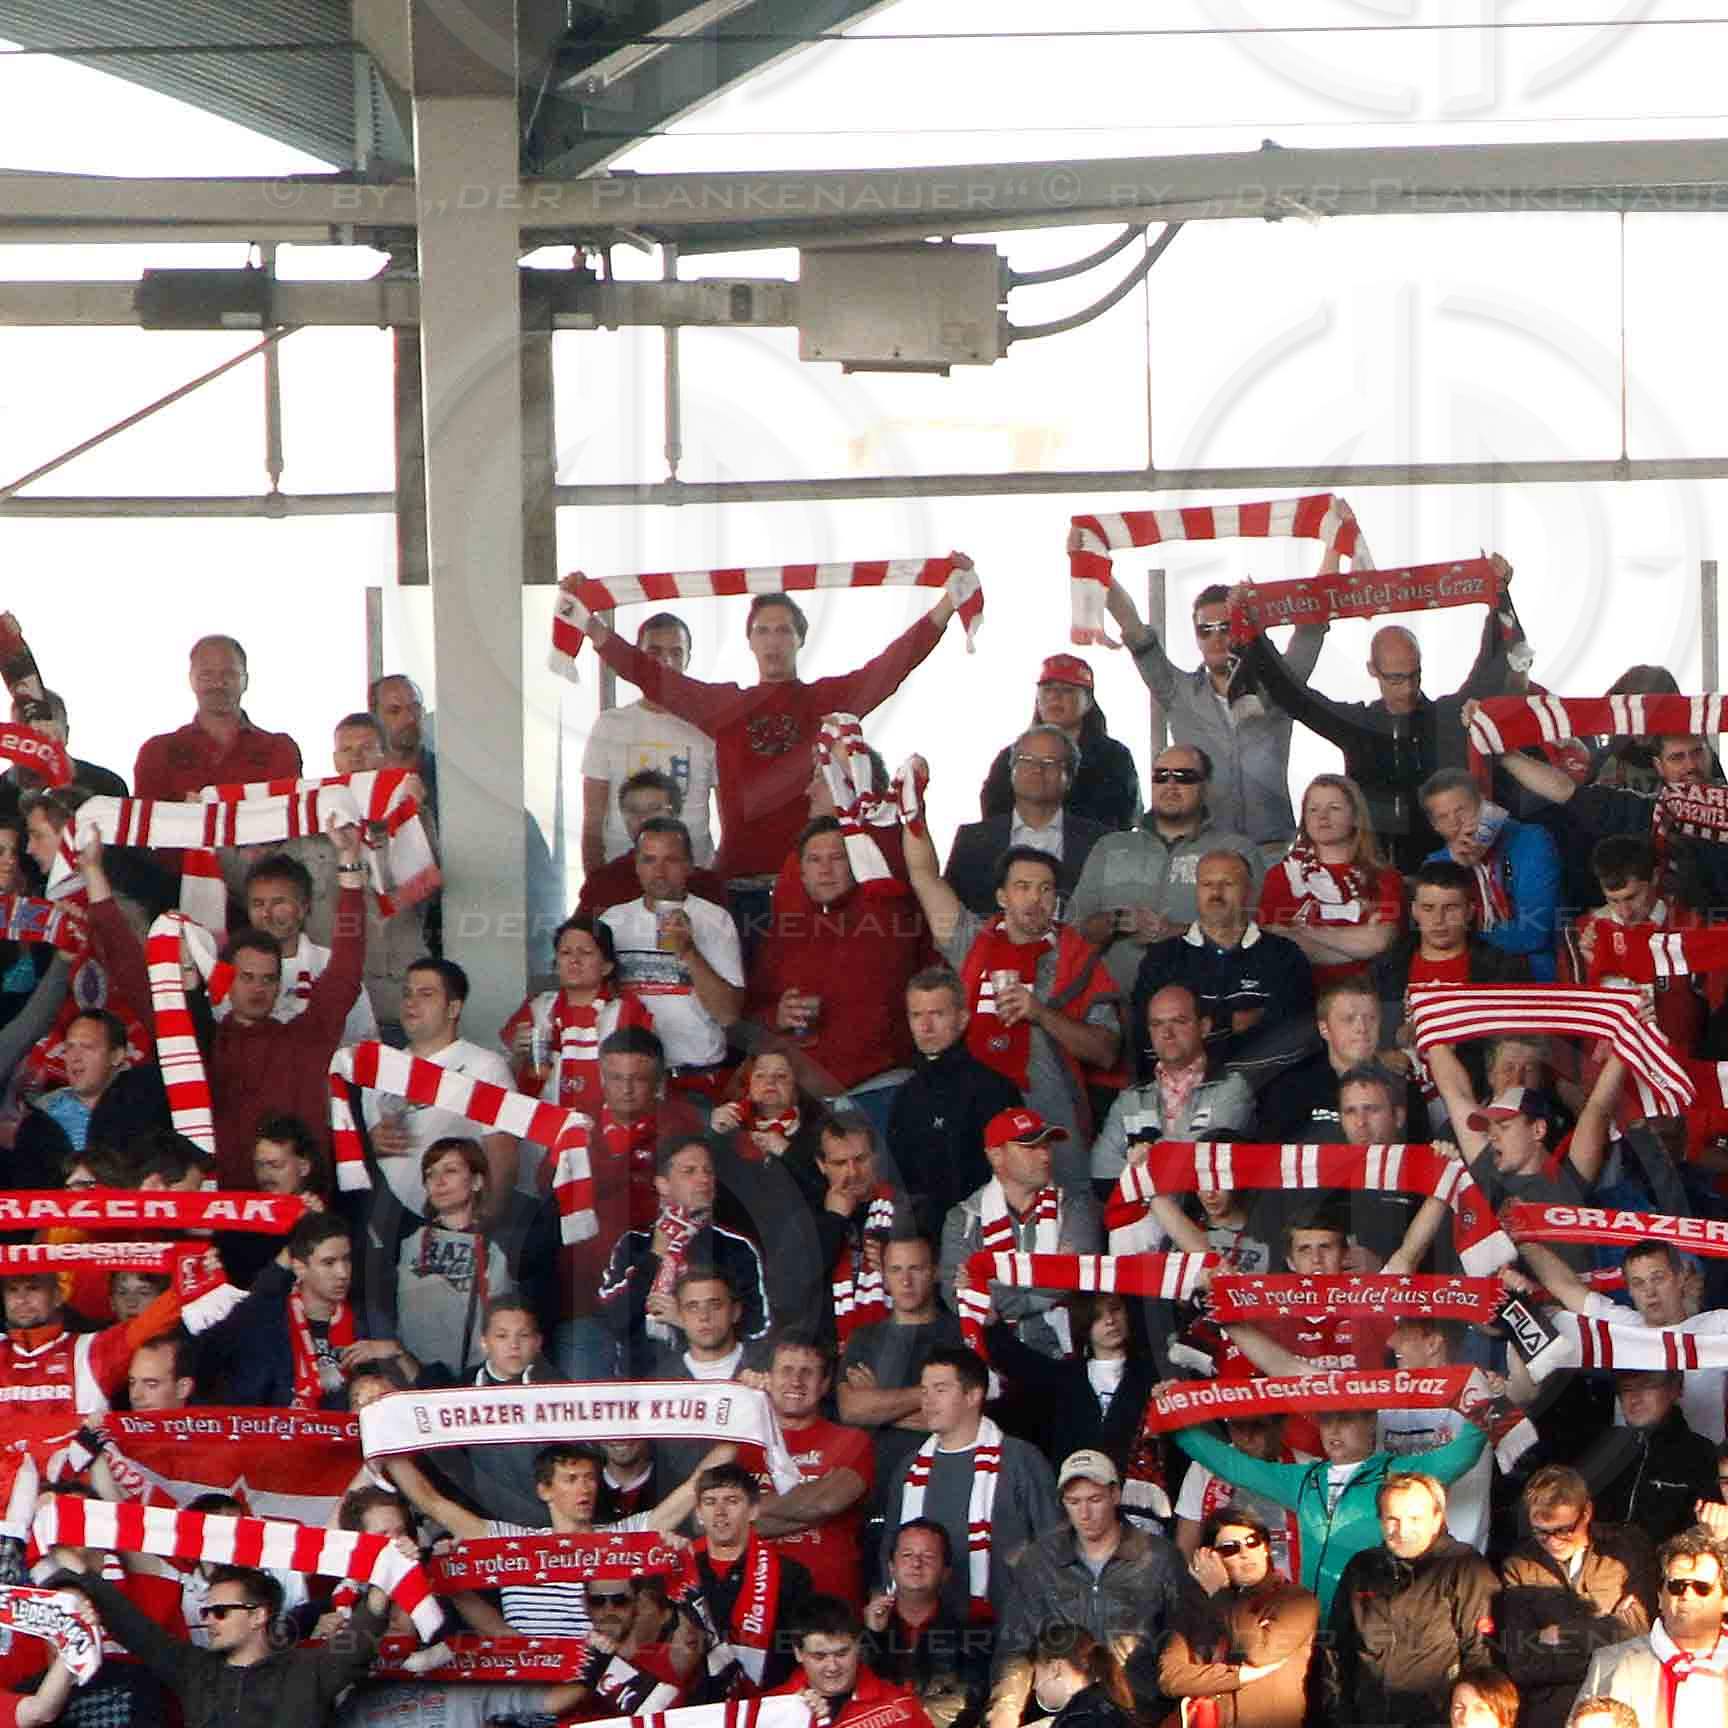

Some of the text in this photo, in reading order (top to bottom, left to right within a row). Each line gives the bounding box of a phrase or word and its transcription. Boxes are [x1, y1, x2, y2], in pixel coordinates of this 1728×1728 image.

[1439, 574, 1485, 597] Graz
[202, 1199, 278, 1222] AK
[1226, 1286, 1479, 1308] Die roten Teufel aus Graz
[1502, 1303, 1547, 1352] FILA
[1190, 1372, 1448, 1405] roten Teufel aus Graz
[122, 1415, 339, 1436] Die roten Teufel aus
[439, 1403, 707, 1428] GRAZER ATHLETIK KLUB
[474, 1550, 641, 1577] roten Teufel aus
